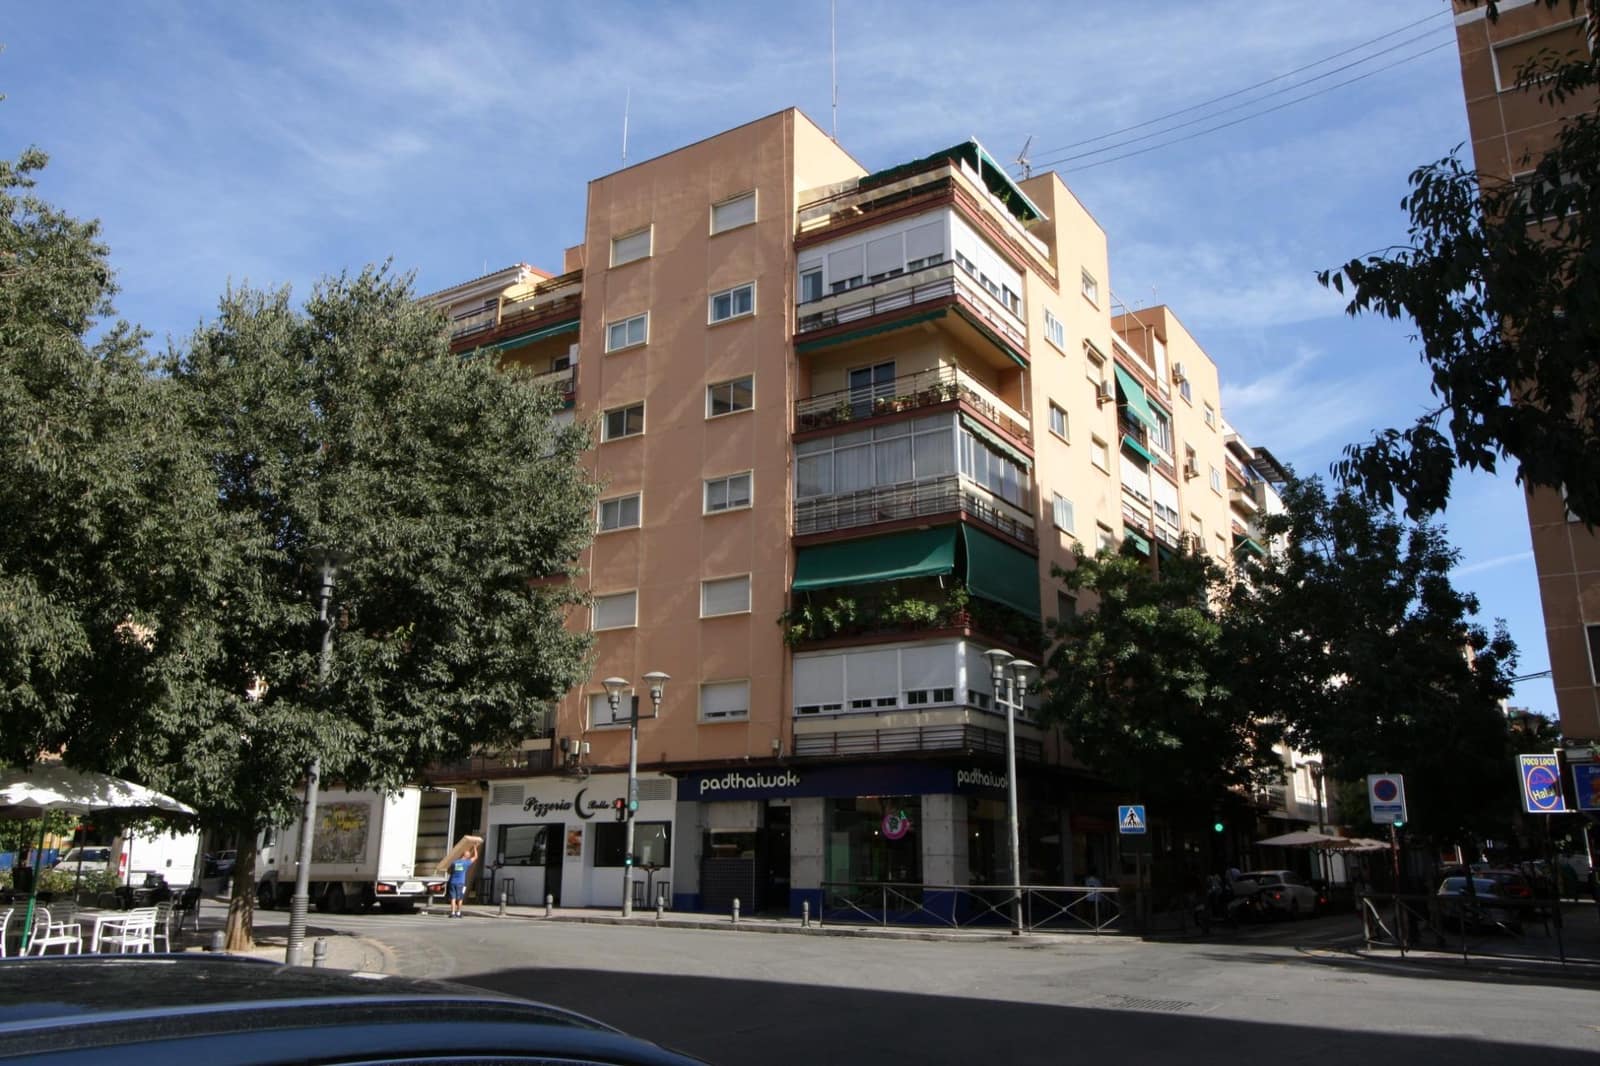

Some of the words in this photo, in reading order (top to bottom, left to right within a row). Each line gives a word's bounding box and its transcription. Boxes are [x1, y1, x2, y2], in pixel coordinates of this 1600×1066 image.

[1540, 758, 1555, 766] LOCO
[700, 770, 797, 795] padthaiwok
[523, 797, 571, 817] Pizzeria
